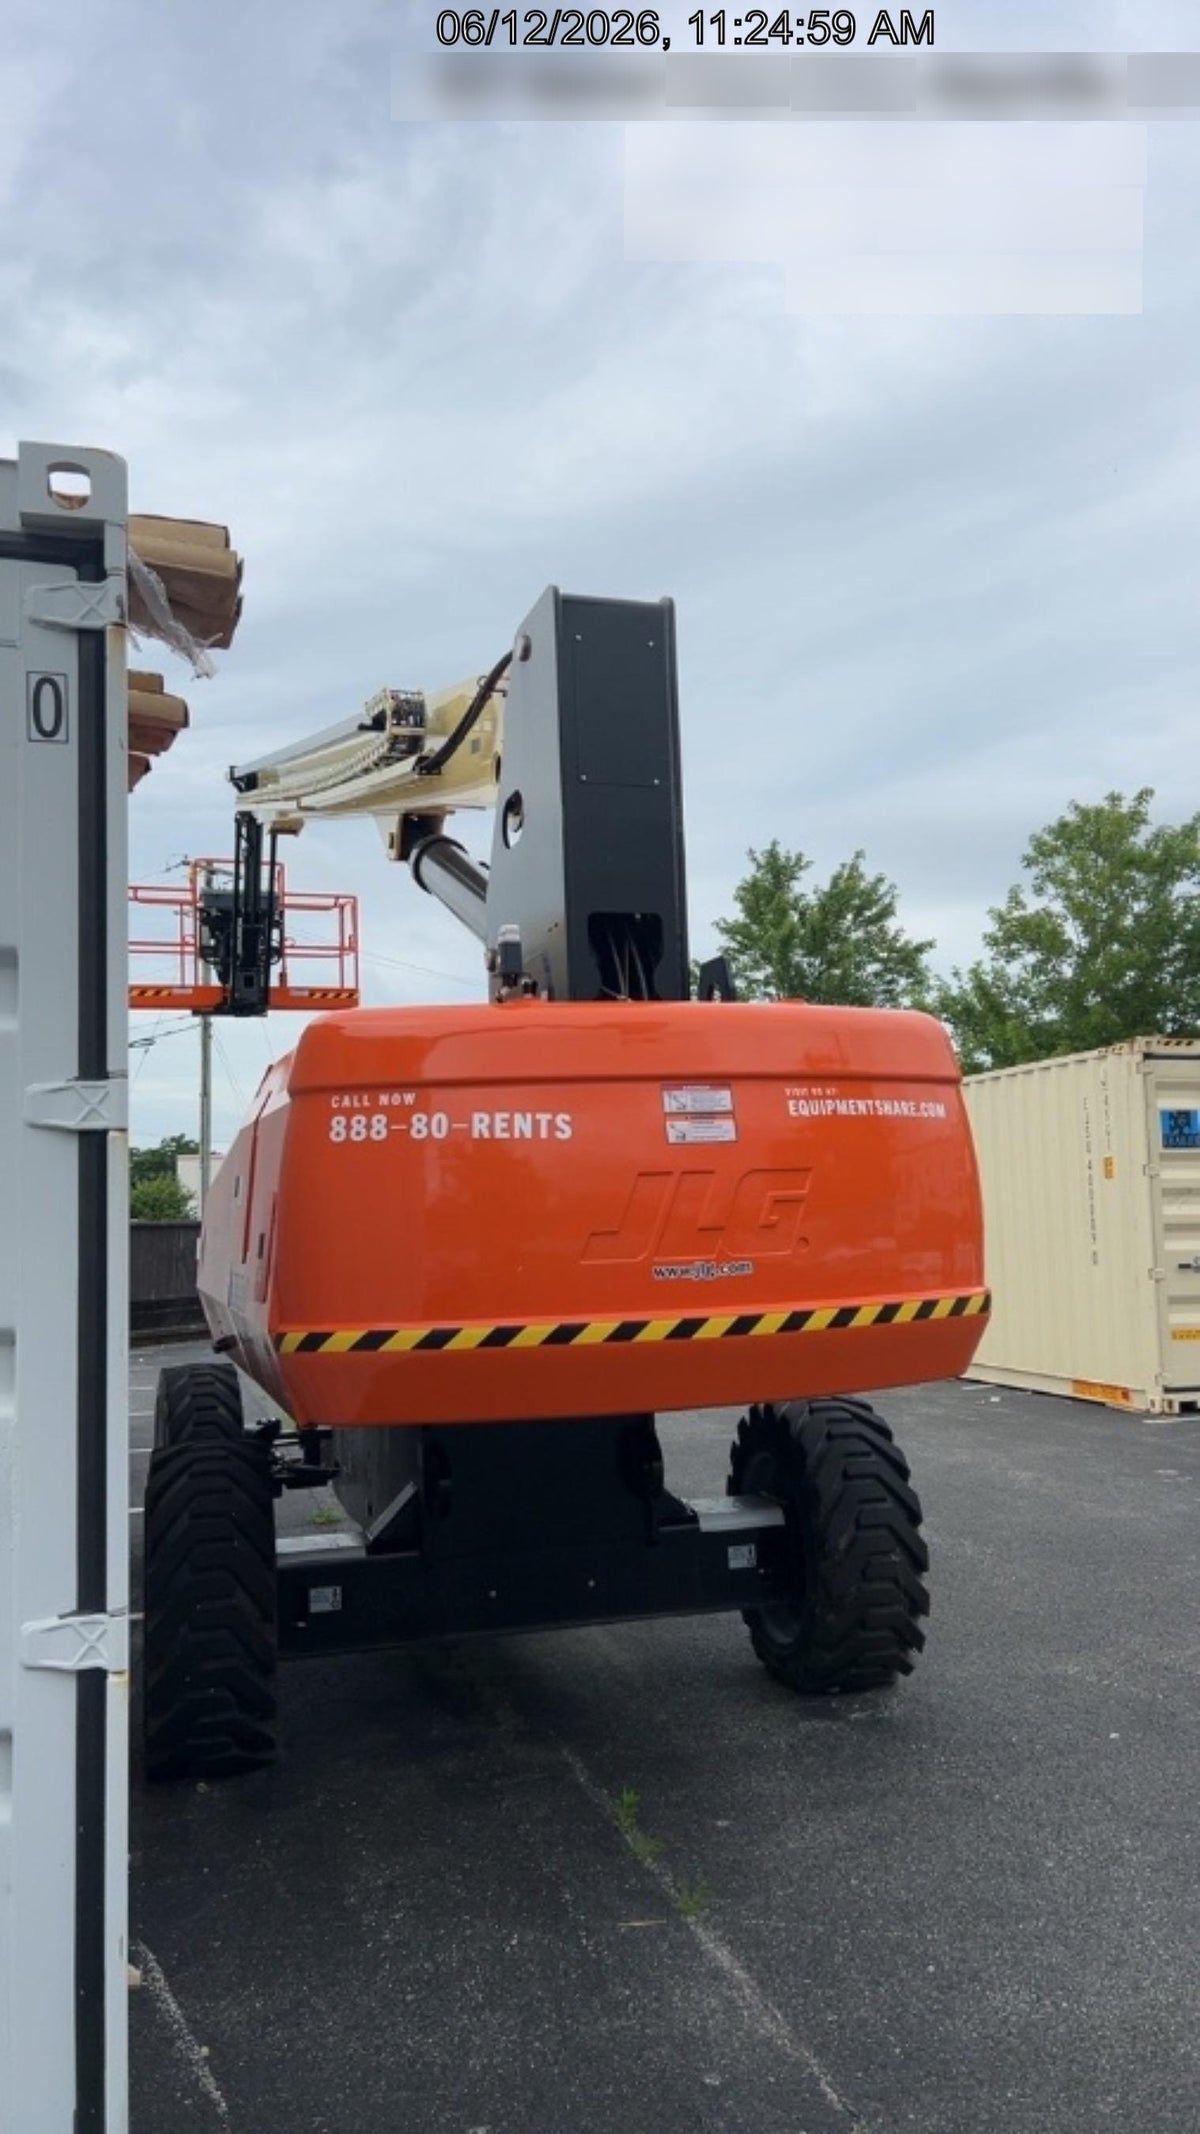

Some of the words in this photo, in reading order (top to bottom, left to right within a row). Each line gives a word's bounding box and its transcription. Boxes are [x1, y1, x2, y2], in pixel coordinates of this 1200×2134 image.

[32, 676, 63, 739] 0
[331, 1095, 370, 1108] CALL
[379, 1092, 416, 1106] NOW
[788, 1099, 946, 1119] EQUIPMENTSHARE.COM
[329, 1111, 573, 1143] 888-80-RENTS
[579, 1167, 814, 1264] JLG
[652, 1261, 753, 1281] www.jlg.com
